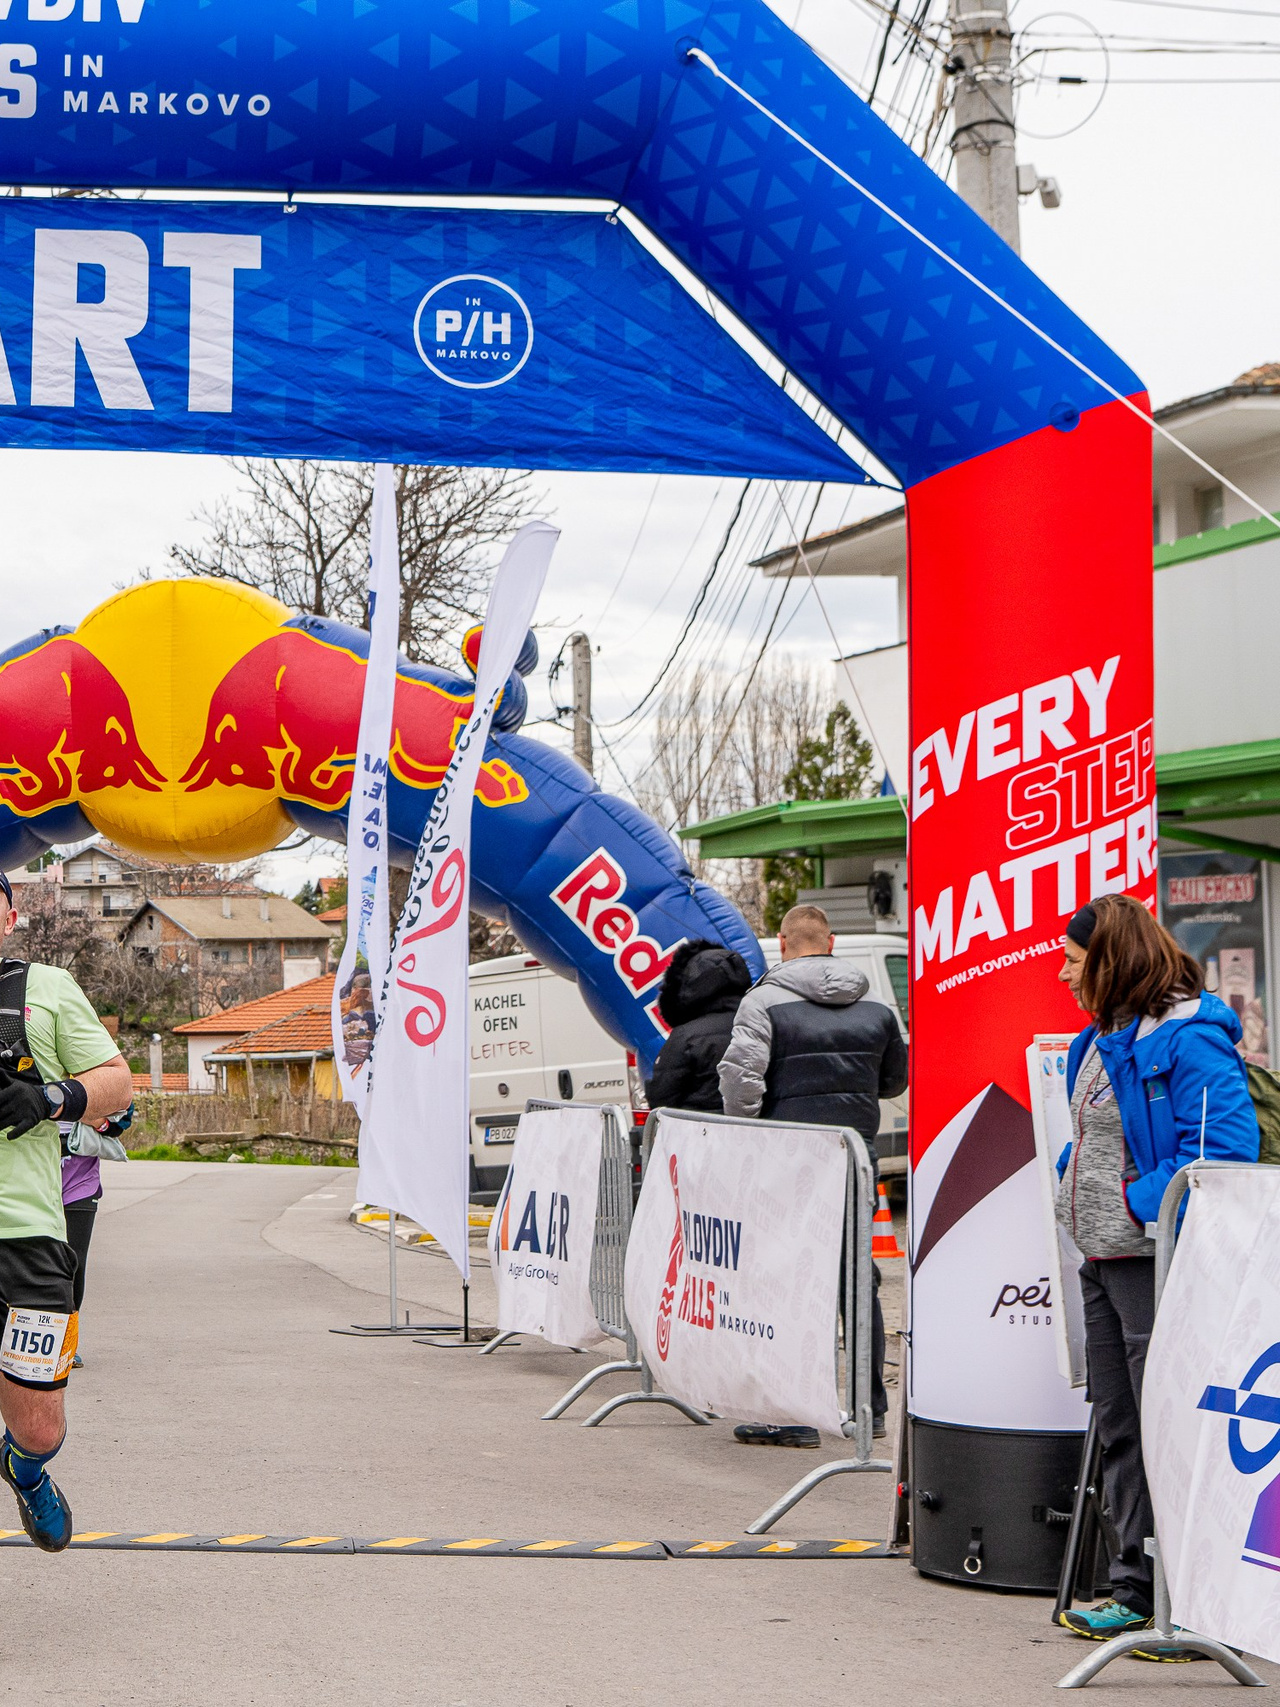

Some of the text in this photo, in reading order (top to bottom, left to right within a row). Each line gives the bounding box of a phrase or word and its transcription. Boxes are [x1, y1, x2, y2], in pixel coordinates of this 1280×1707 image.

[63, 54, 104, 78] IN
[63, 91, 271, 116] MARKOVO
[465, 297, 481, 306] IN
[436, 309, 511, 346] P/H
[436, 349, 511, 361] MARKOVO
[912, 655, 1120, 822] EVERY
[1006, 717, 1155, 850] STEP
[550, 847, 688, 999] Red
[474, 994, 526, 1012] KACHEL
[483, 1016, 518, 1033] ÖFEN
[471, 1041, 533, 1060] LEITER
[719, 1290, 730, 1306] IN
[38, 1314, 51, 1324] 12K
[719, 1313, 775, 1340] MARKOVO
[11, 1328, 55, 1356] 1150
